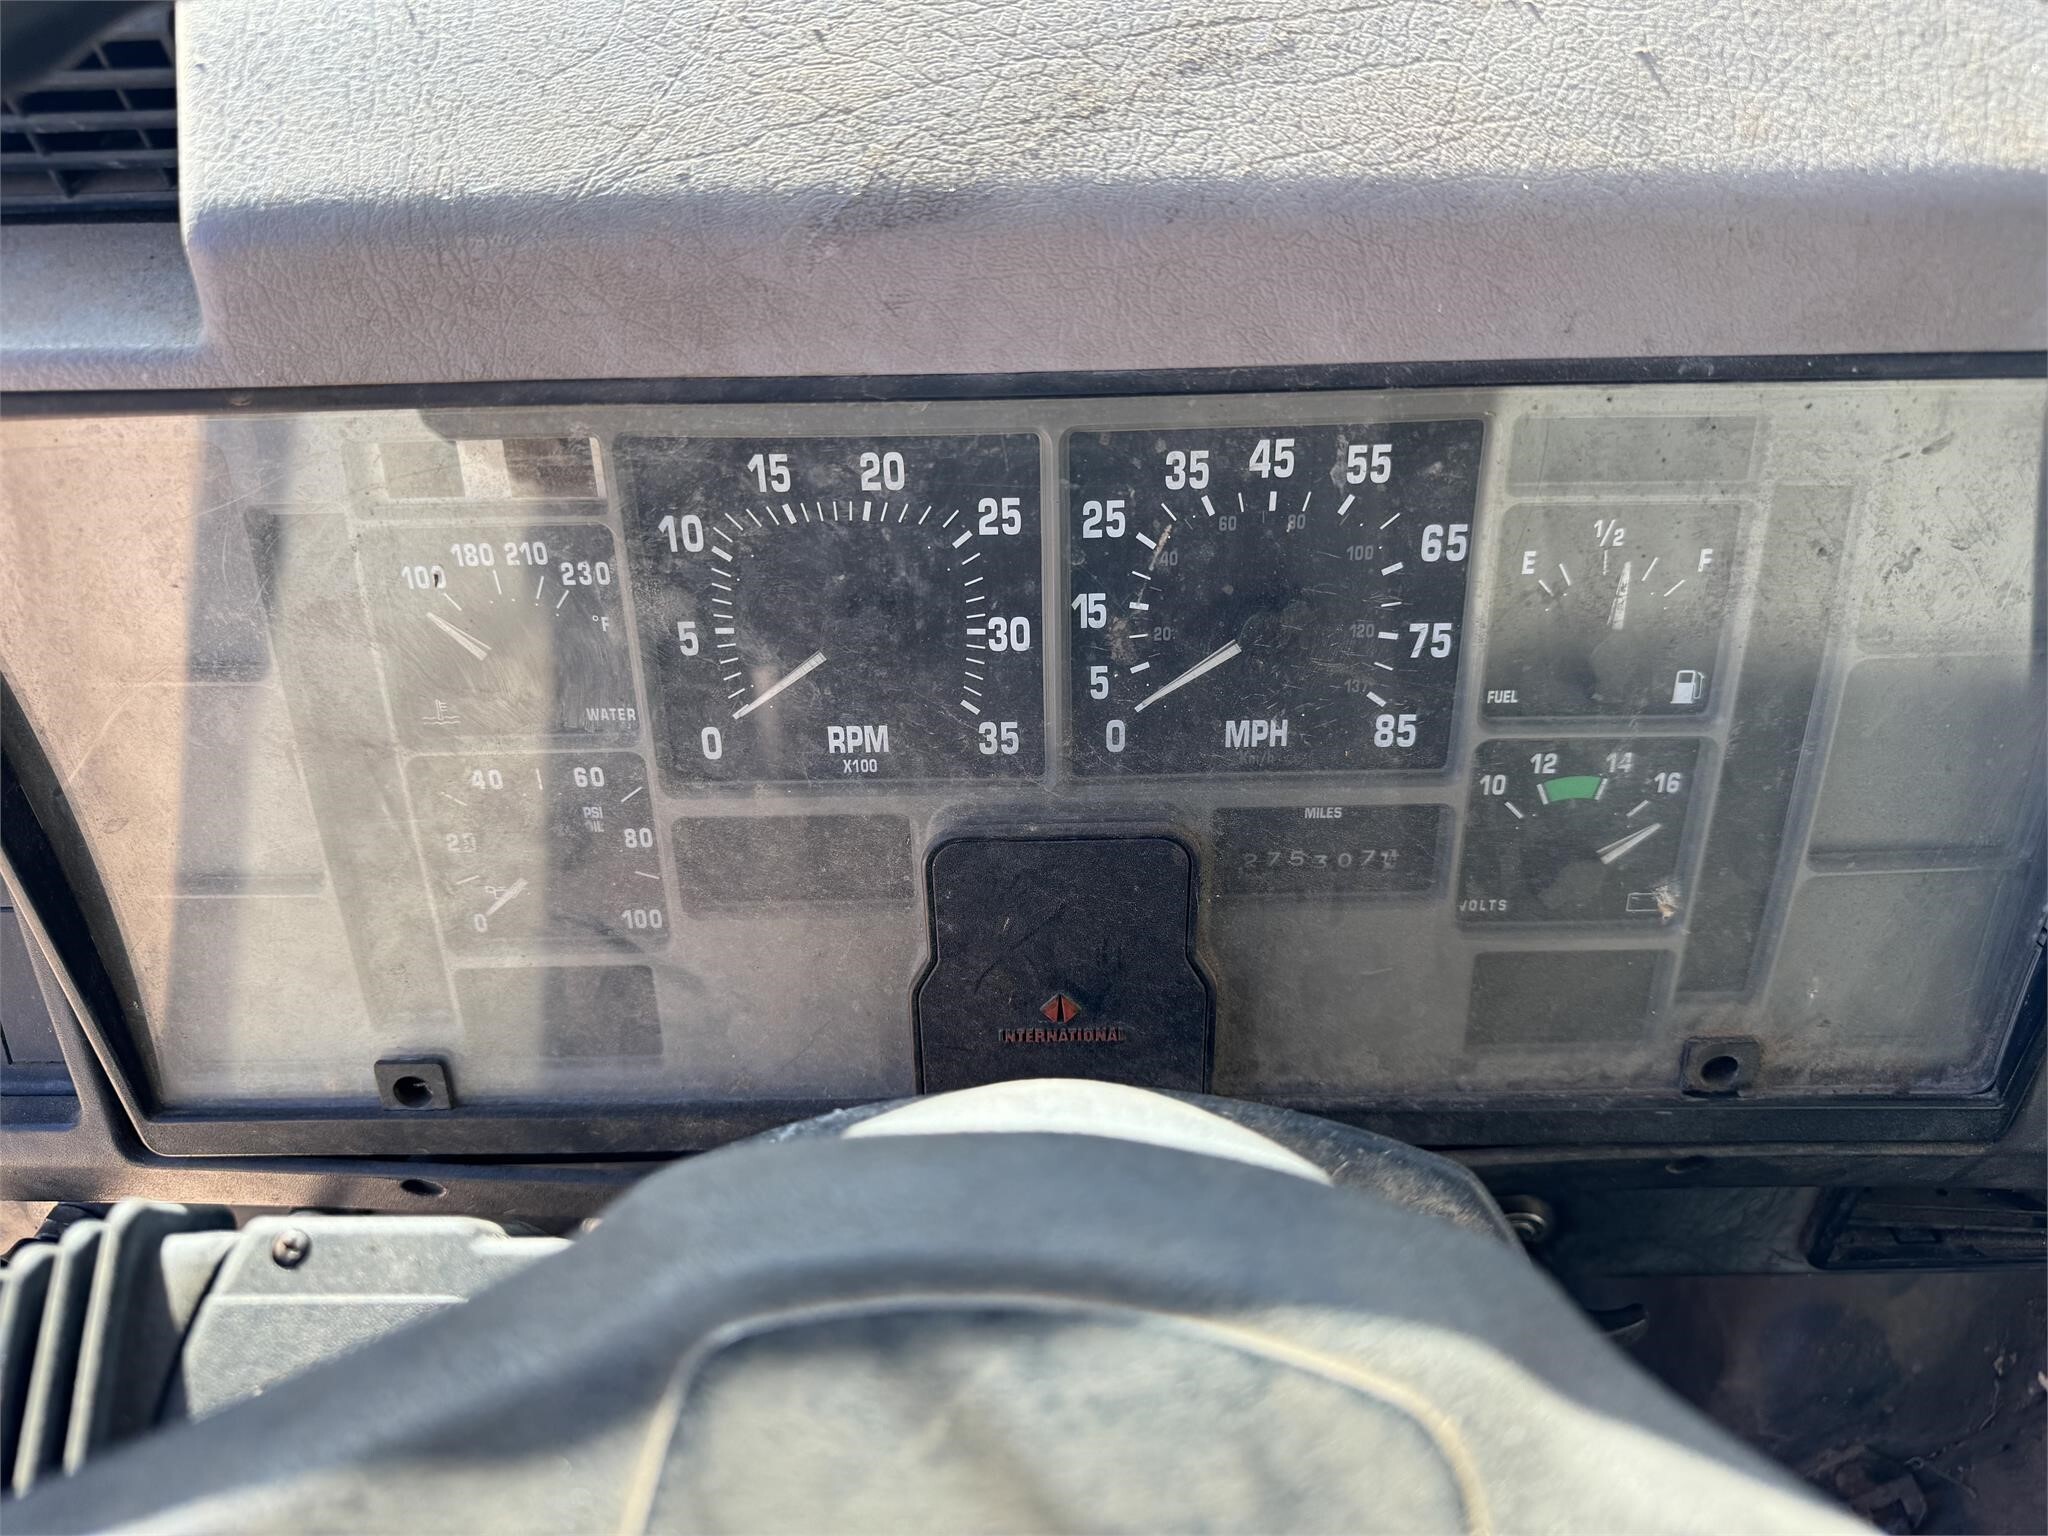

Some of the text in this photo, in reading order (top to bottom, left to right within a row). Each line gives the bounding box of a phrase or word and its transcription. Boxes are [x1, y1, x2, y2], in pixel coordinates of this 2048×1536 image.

[1165, 450, 1210, 490] 35
[1249, 438, 1295, 479] 45
[1346, 444, 1392, 484] 55
[747, 453, 791, 493] 15
[859, 451, 906, 491] 20
[977, 497, 1022, 535] 25
[1082, 500, 1126, 539] 25
[1218, 515, 1237, 531] 60
[1289, 514, 1306, 531] 80
[658, 514, 704, 552] 10
[1420, 524, 1468, 562] 65
[450, 543, 494, 567] 180
[504, 542, 548, 565] 210
[1346, 545, 1374, 561] 100
[1521, 551, 1537, 575] E
[1697, 549, 1713, 572] F
[402, 566, 447, 590] 100
[560, 561, 611, 586] 230
[1072, 592, 1107, 628] 15
[677, 621, 699, 656] 5
[988, 616, 1030, 652] 30
[1153, 626, 1171, 641] 20
[1351, 624, 1375, 639] 120
[1409, 622, 1453, 658] 75
[1090, 665, 1109, 700] 5
[1487, 690, 1518, 704] FUEL
[586, 708, 636, 721] WATER
[827, 725, 890, 754] RPM
[978, 721, 1020, 755] 35
[1105, 719, 1126, 753] 0
[1224, 719, 1288, 748] MPH
[1373, 714, 1417, 747] 85
[701, 726, 723, 760] 0
[843, 759, 878, 774] X100
[1530, 753, 1558, 774] 12
[1606, 752, 1633, 773] 14
[471, 769, 504, 790] 40
[573, 766, 606, 788] 60
[1479, 774, 1507, 796] 10
[1654, 772, 1681, 793] 16
[582, 806, 603, 819] PSI
[1304, 807, 1342, 819] MILES
[624, 827, 653, 849] 80
[473, 913, 488, 933] 0
[621, 909, 663, 929] 100
